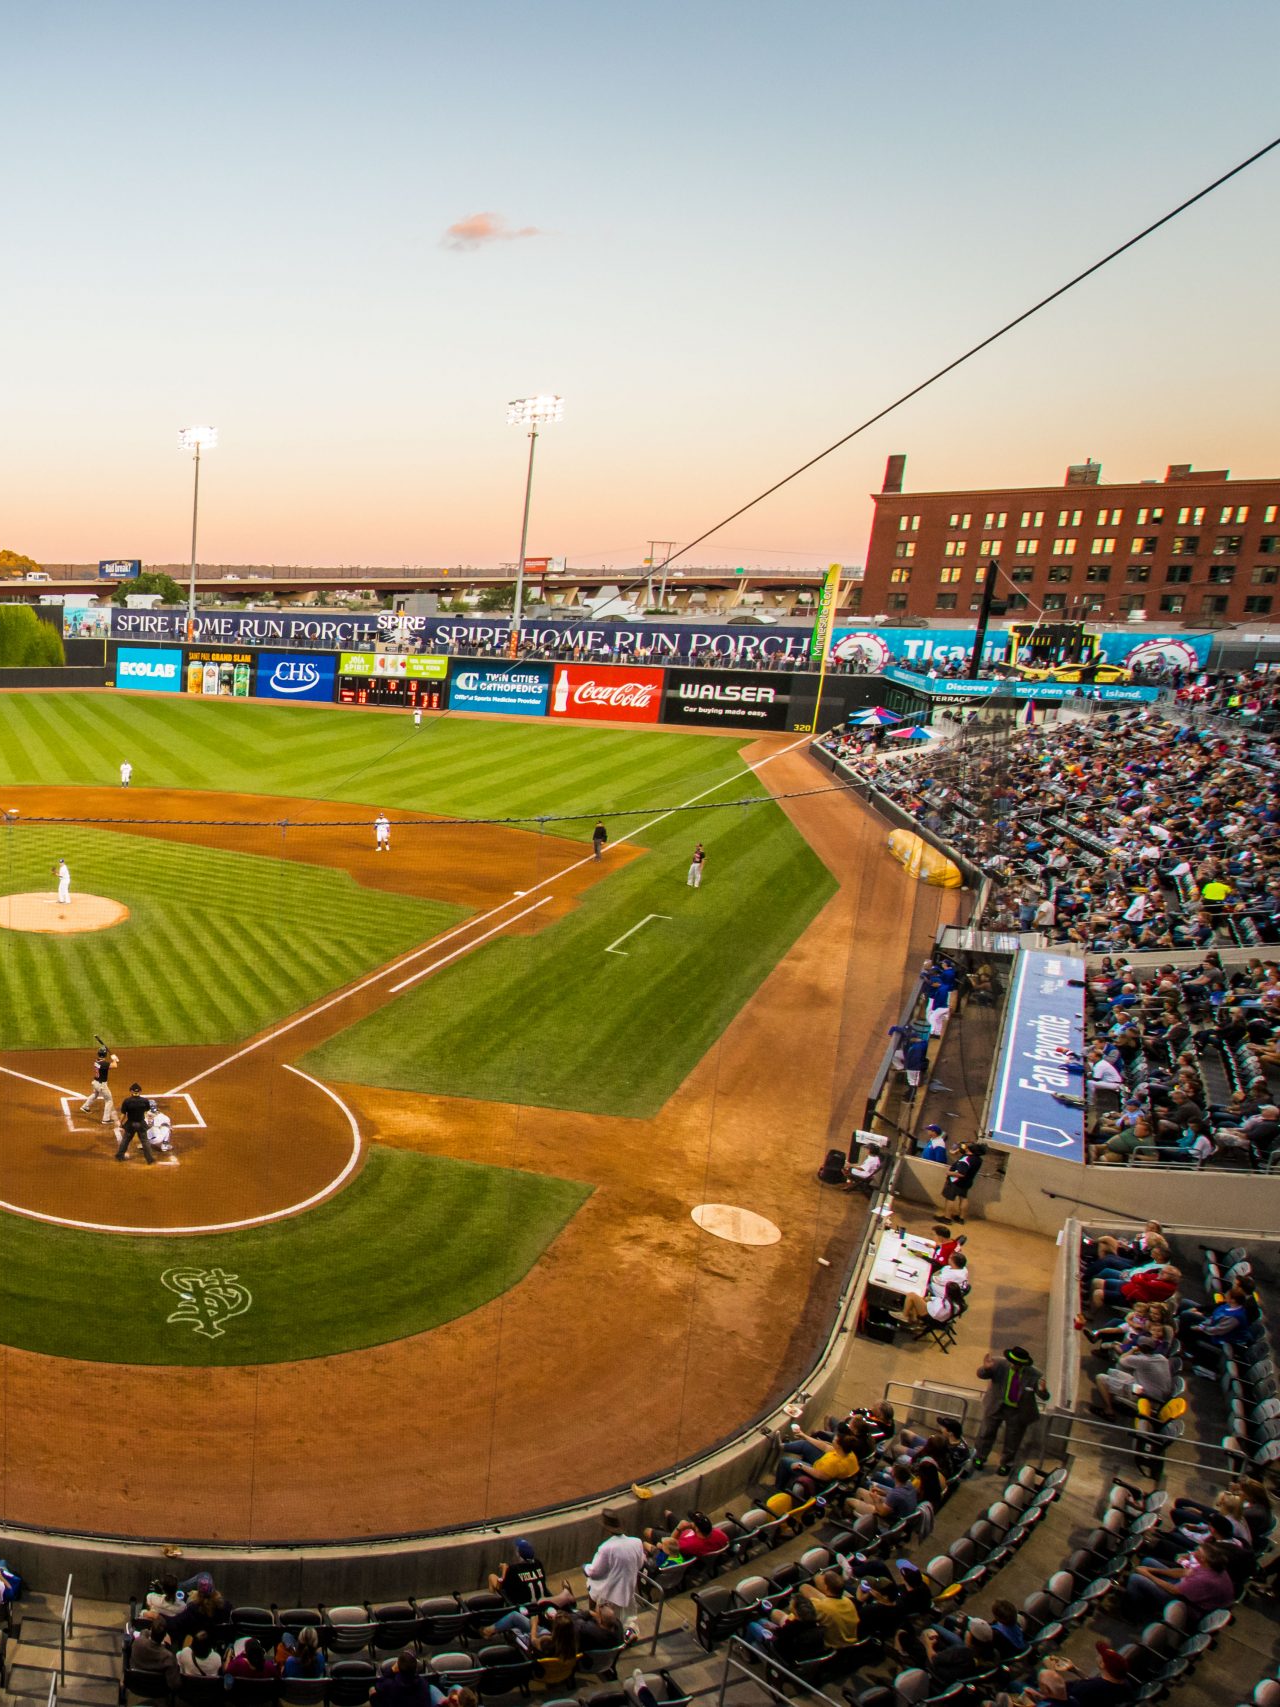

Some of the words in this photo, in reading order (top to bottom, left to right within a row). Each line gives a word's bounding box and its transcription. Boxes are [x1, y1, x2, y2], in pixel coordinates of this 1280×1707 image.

[820, 583, 834, 607] Corn
[117, 615, 170, 633] SPIRE
[175, 617, 232, 636] HOME
[239, 619, 284, 638] RUN
[290, 621, 369, 641] PORCH
[377, 616, 426, 630] SPIRE
[813, 608, 829, 656] Minnesota
[435, 625, 510, 648] SPIRE
[520, 629, 604, 651] HOME
[615, 630, 680, 654] RUN
[691, 632, 811, 660] PORCH
[189, 652, 200, 660] SAINT
[201, 653, 210, 661] PAUL
[211, 653, 232, 662] GRAND
[233, 654, 251, 662] SLAM
[120, 661, 175, 678] ECOLAB
[276, 662, 315, 681] CHS
[486, 673, 508, 682] TWIN
[511, 674, 540, 684] CITIES
[479, 683, 543, 694] ORTHOPEDICS
[574, 680, 657, 708] Coca-Cola
[680, 683, 775, 703] WALSER
[946, 683, 988, 692] Discover
[1016, 687, 1039, 695] very
[1106, 689, 1142, 699] island.
[931, 695, 972, 703] TERRACE
[698, 707, 723, 715] buying
[725, 708, 745, 716] made
[793, 724, 811, 732] 320
[1022, 1014, 1071, 1064] favorite
[1019, 1065, 1070, 1094] Fan
